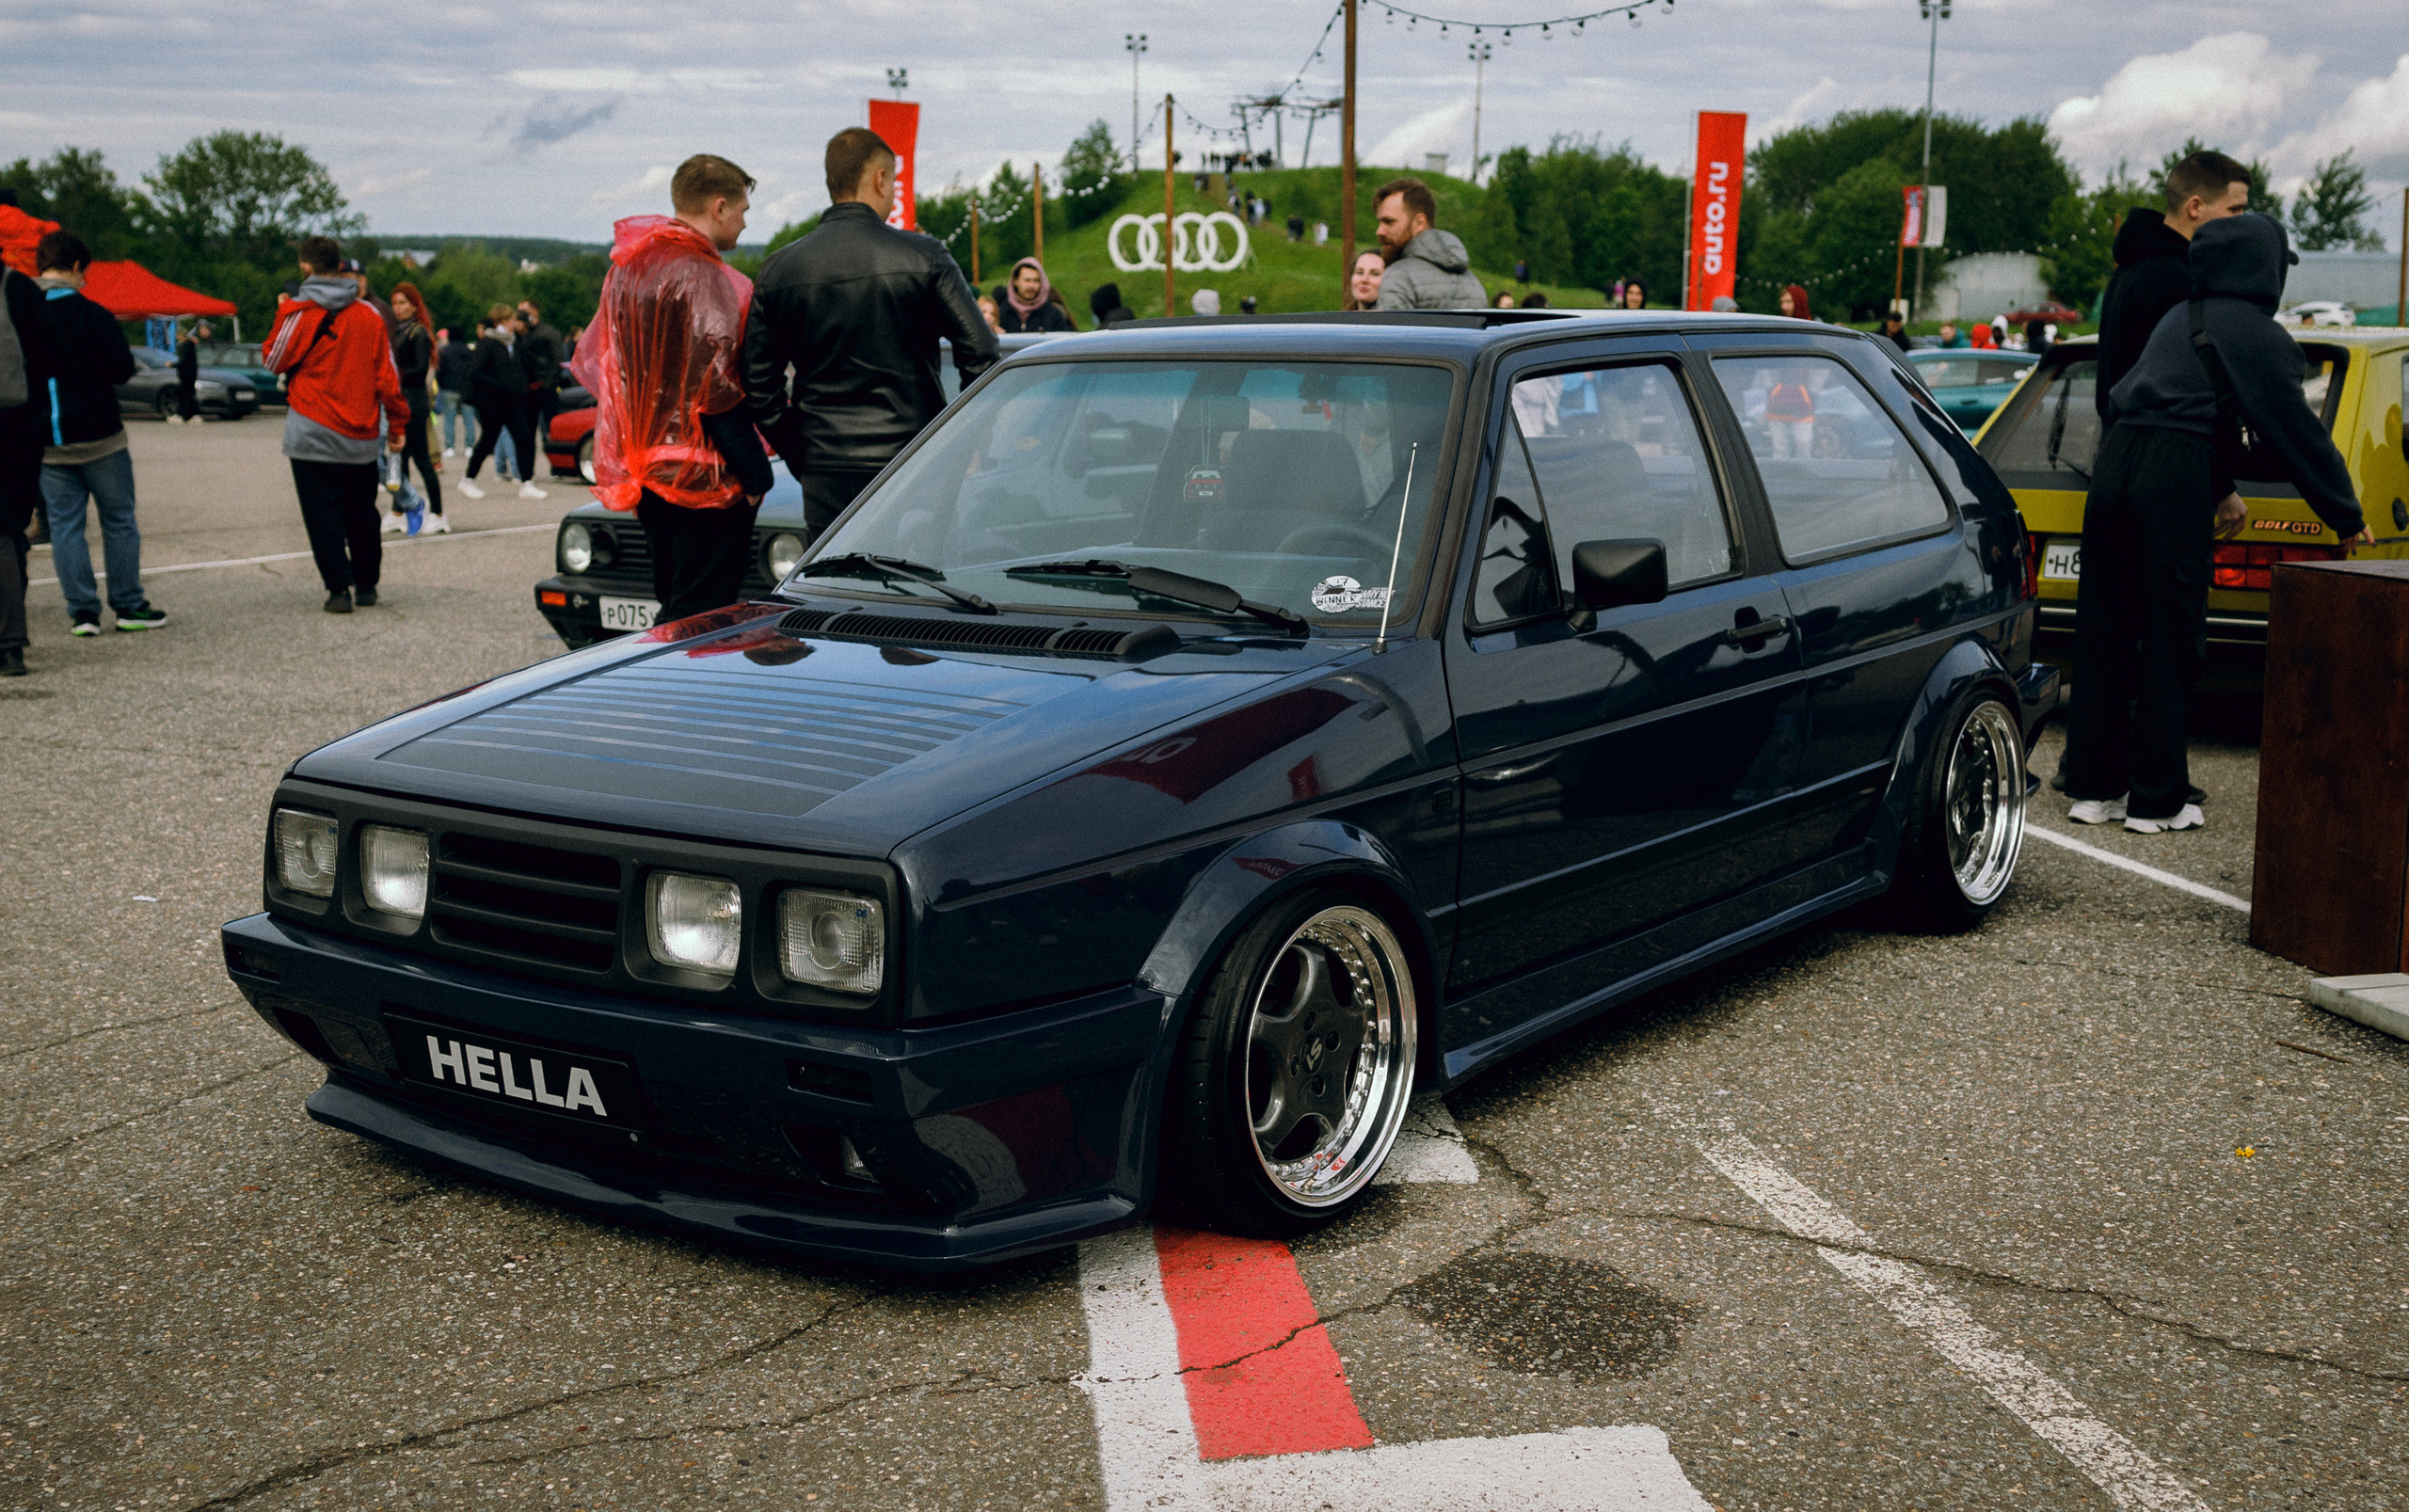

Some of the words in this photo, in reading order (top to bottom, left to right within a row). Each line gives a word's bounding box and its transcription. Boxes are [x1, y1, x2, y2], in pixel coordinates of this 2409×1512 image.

[1703, 161, 1730, 276] auto.ru
[2254, 519, 2290, 530] GOLF
[2291, 521, 2321, 534] GTD
[1316, 595, 1357, 606] WINNER
[426, 1034, 608, 1117] HELLA
